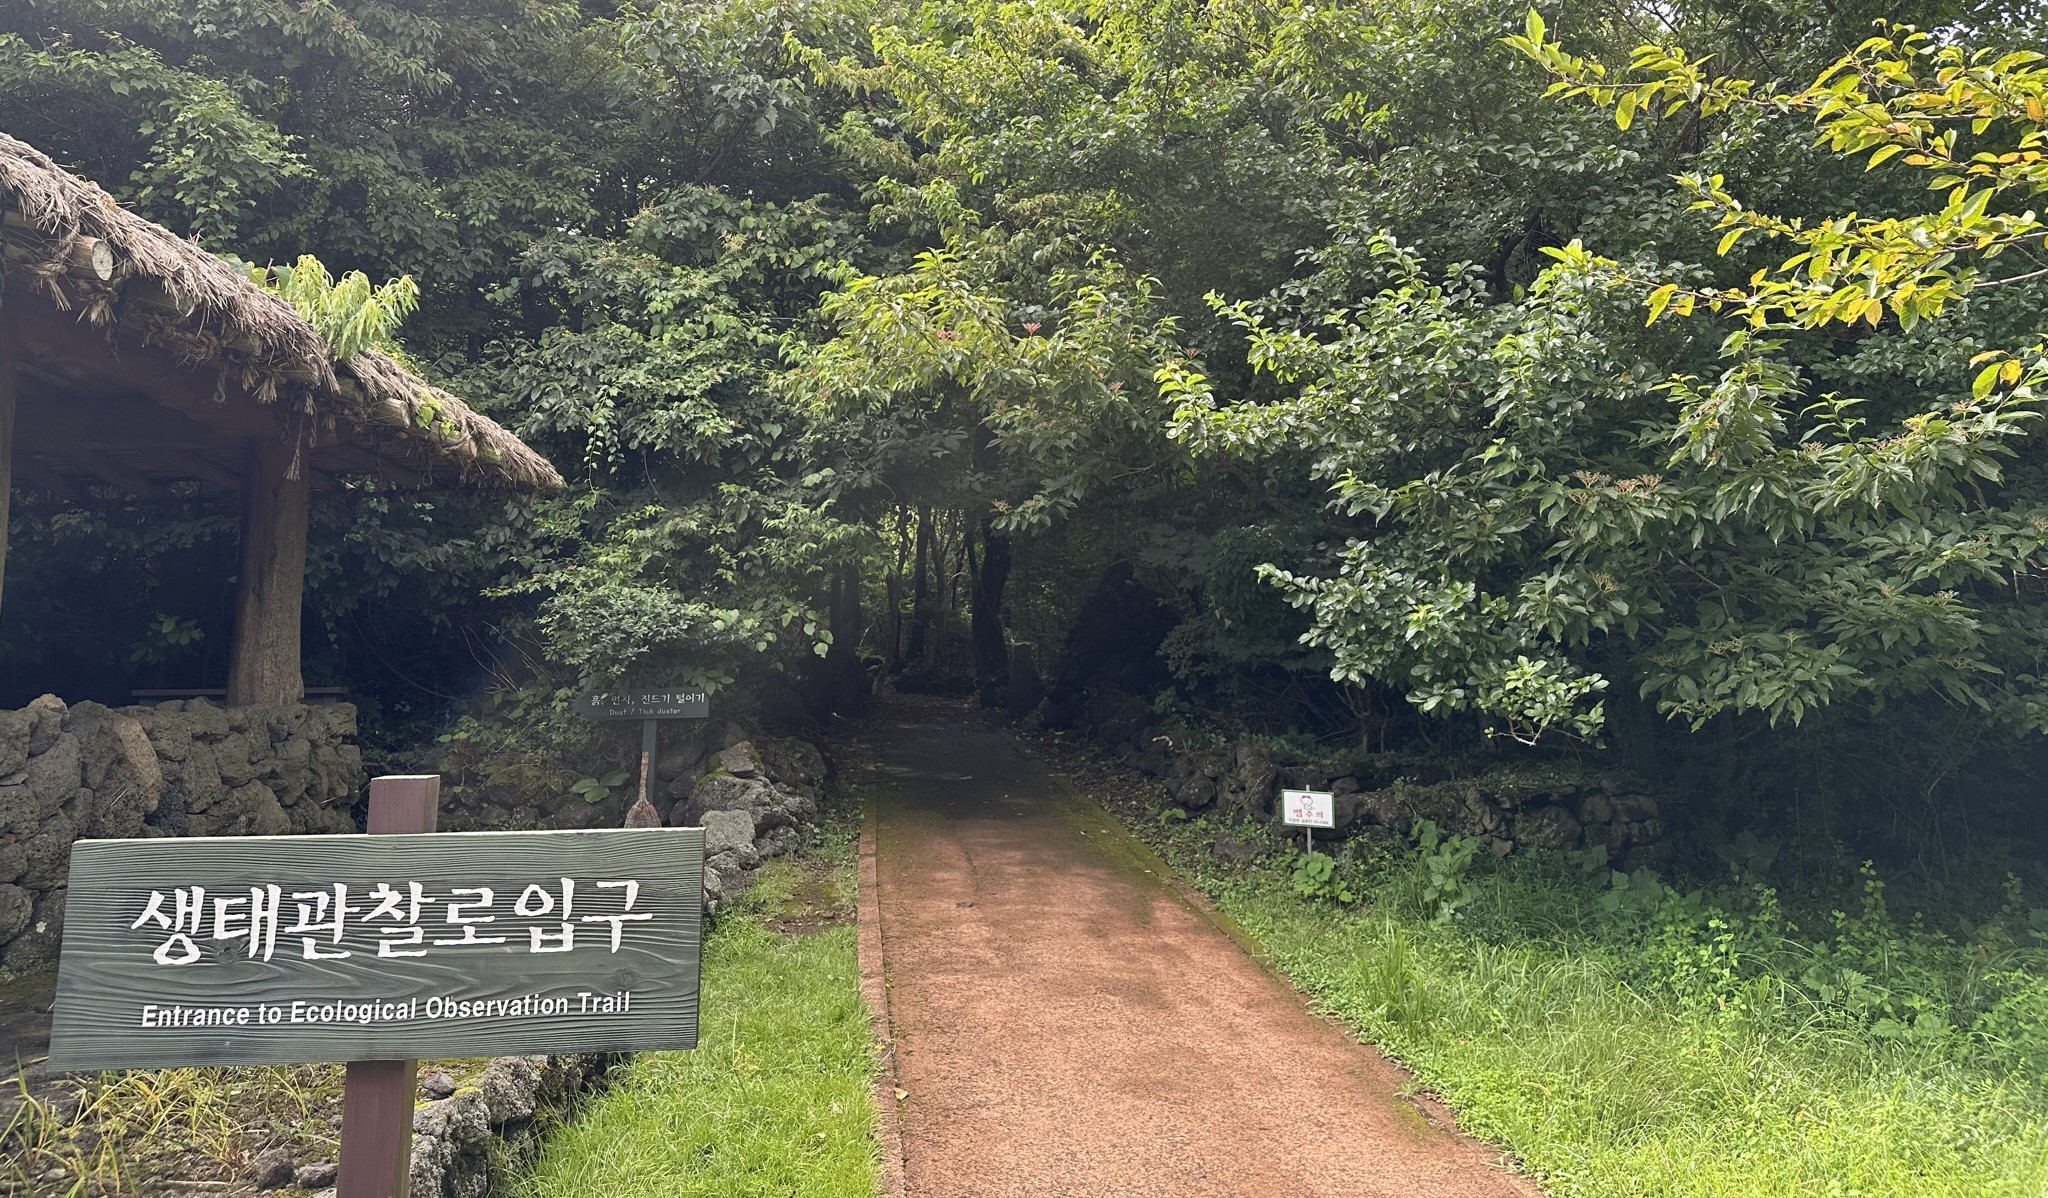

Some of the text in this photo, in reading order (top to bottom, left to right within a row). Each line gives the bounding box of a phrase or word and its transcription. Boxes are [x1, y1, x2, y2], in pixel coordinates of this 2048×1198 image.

[641, 693, 670, 705] 진드기
[609, 708, 627, 716] Dust
[638, 708, 654, 716] Tick
[130, 877, 655, 966] 생태관찰로입구
[140, 991, 632, 1029] Entrance to Ecological Observation Trail
